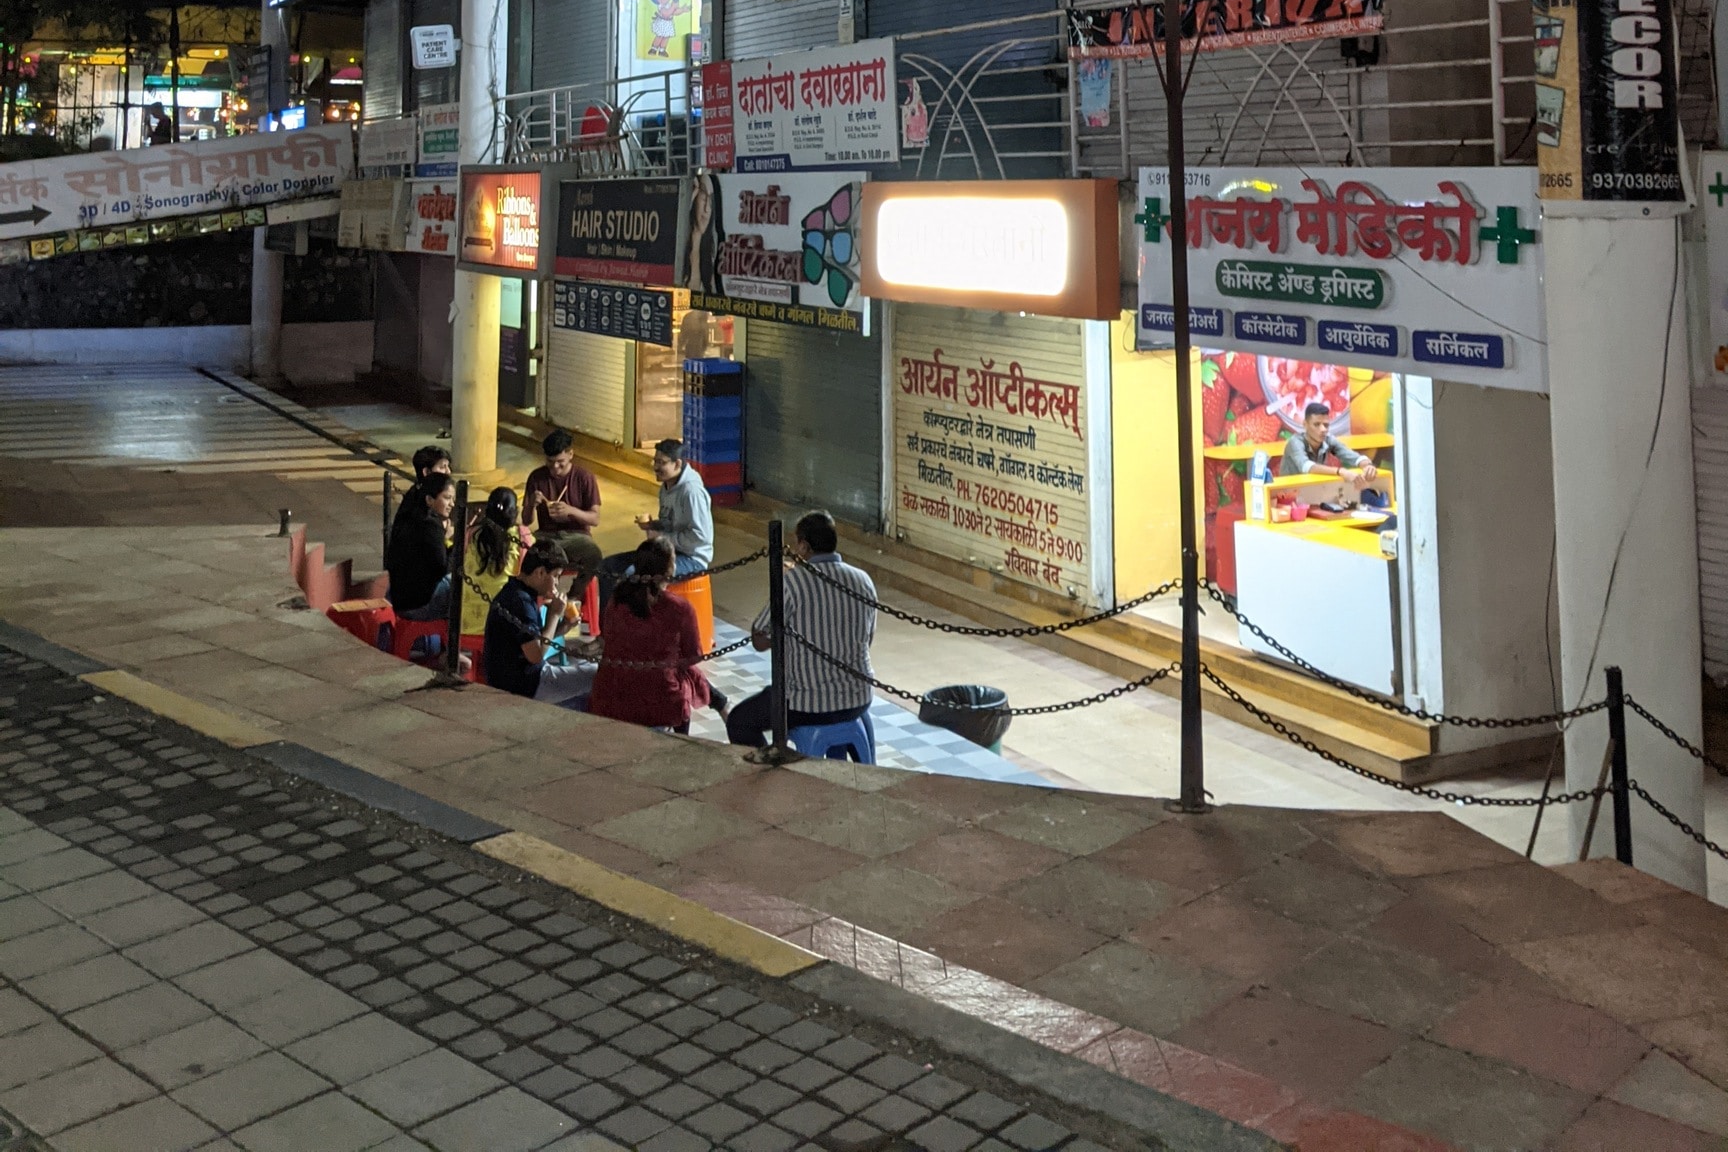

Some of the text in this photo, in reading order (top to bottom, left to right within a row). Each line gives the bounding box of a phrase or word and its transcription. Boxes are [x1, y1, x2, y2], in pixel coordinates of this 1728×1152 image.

[737, 61, 795, 118] दातांचा
[800, 57, 886, 111] दवाखाना
[111, 201, 131, 214] 4D
[242, 182, 279, 199] Color
[283, 174, 335, 195] Doppler
[571, 209, 660, 243] HAIR STUDIO
[1294, 179, 1477, 265] मेडिको
[1221, 262, 1273, 292] केमिस्ट
[1426, 334, 1490, 360] सर्जिकल
[900, 349, 960, 403] आर्यन
[976, 484, 1059, 526] 7620504715
[985, 515, 993, 537] 2
[1040, 533, 1047, 554] 5
[1057, 536, 1083, 564] 9:00
